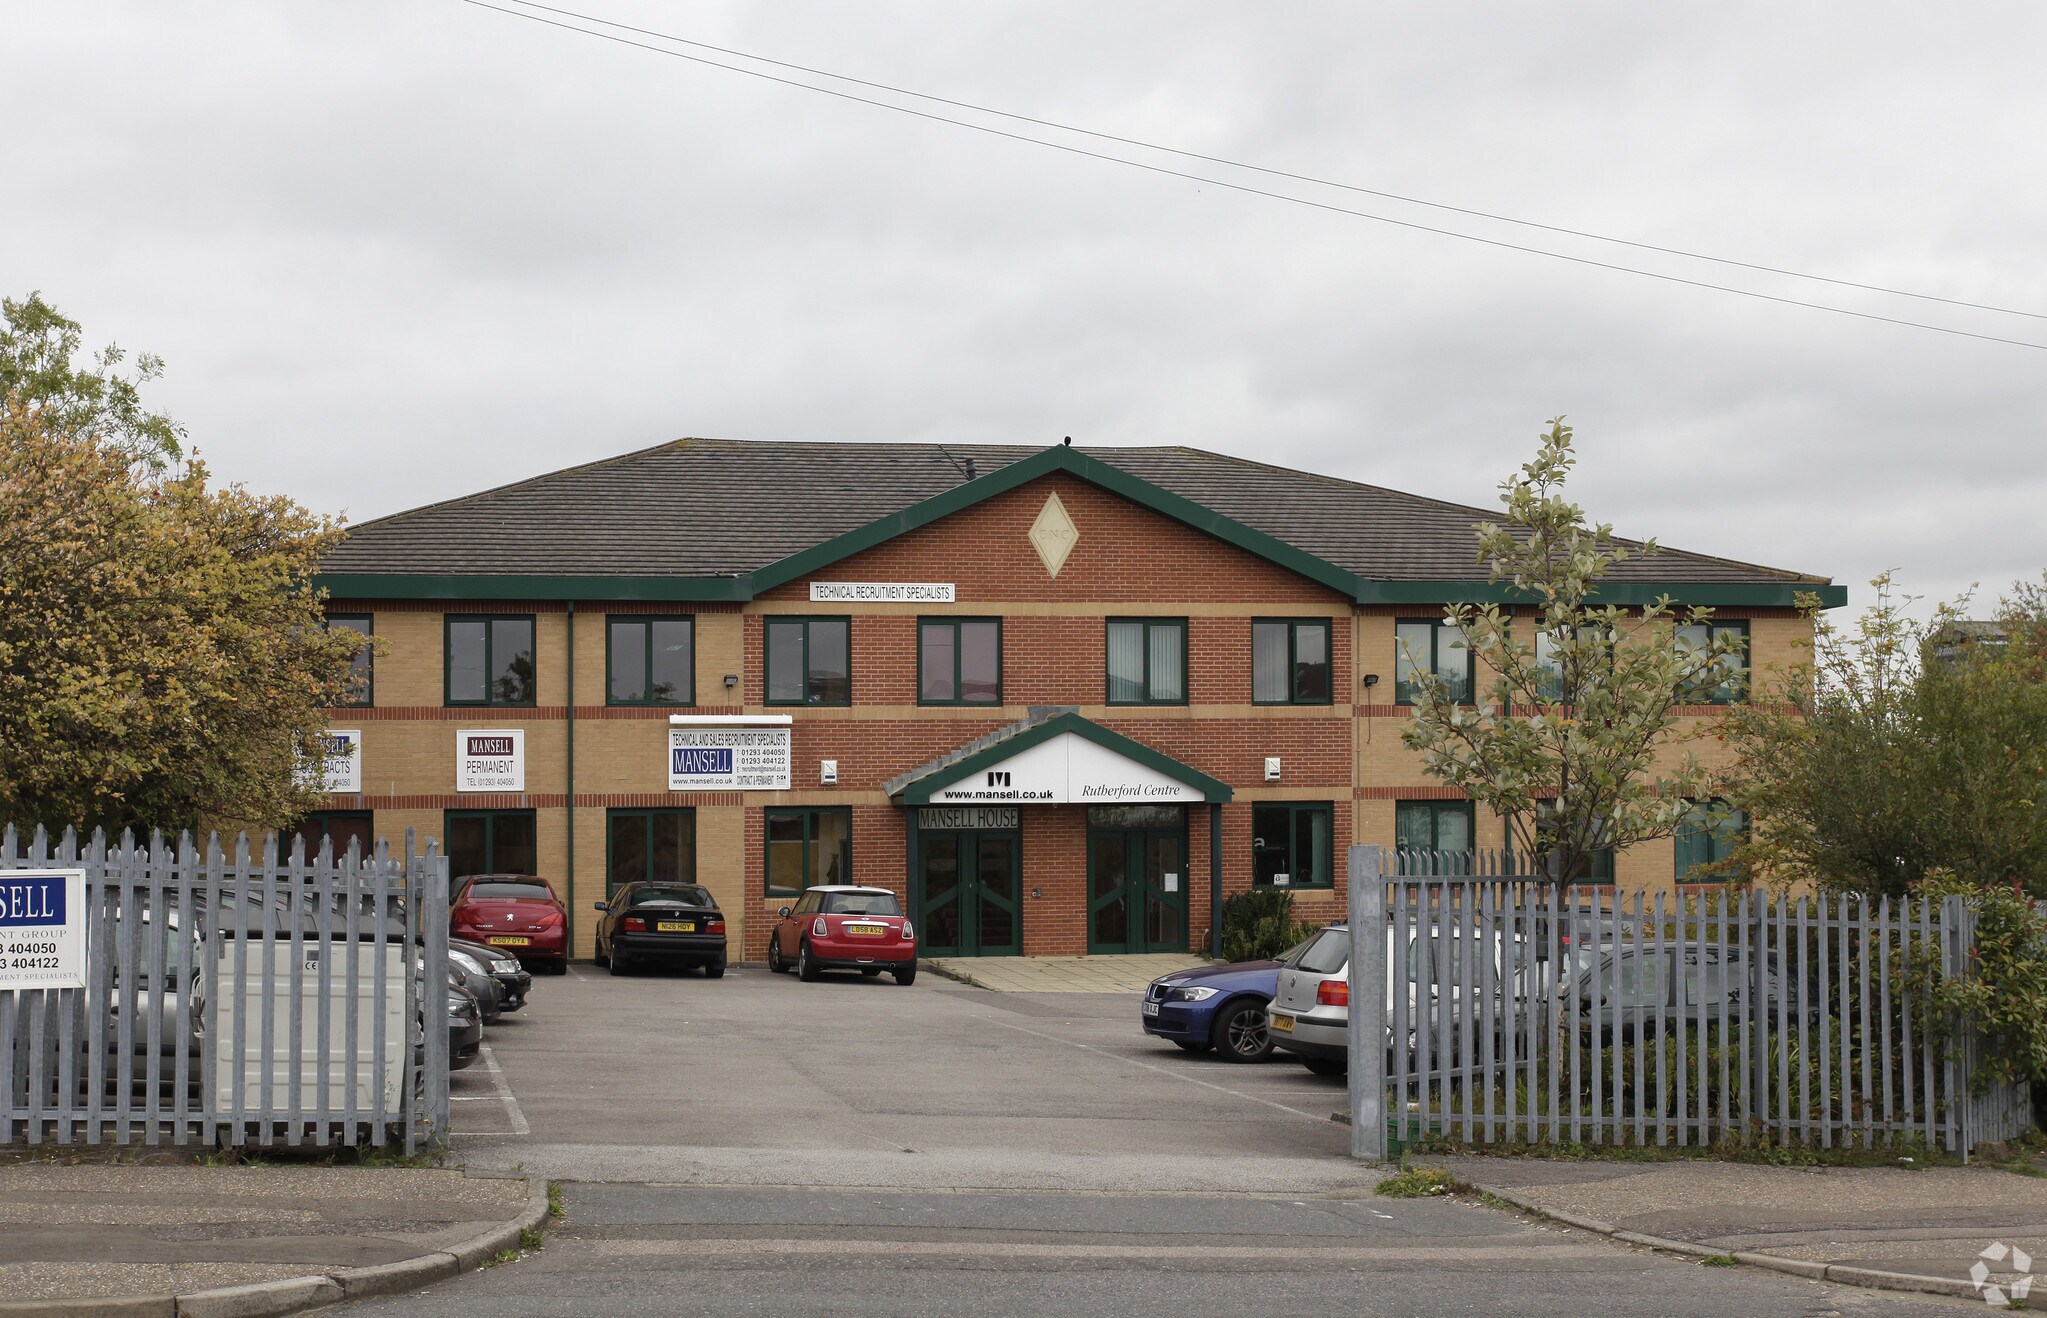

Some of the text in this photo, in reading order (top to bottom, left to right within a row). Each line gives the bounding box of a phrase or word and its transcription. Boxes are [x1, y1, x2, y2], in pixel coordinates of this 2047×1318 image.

[815, 586, 950, 600] TECHNICAL RECRUITMENT SPECIALISTS
[673, 733, 787, 746] TECHNICAL AND SALES RECRUITMENT SPECIALISTS
[471, 739, 511, 753] MANSELL
[466, 760, 514, 774] PERMANENT
[674, 750, 731, 773] MANSELL
[467, 777, 476, 786] TEL
[497, 777, 514, 786] 404050
[672, 777, 733, 785] www.mansell.co.uk
[945, 789, 1054, 799] www.mansell.co.uk
[1082, 783, 1180, 800] Rutherford Centre
[920, 808, 1018, 828] MANSELL HOUSE
[22, 930, 67, 938] GROUP
[8, 943, 56, 954] 404050
[12, 957, 59, 968] 404122
[25, 972, 78, 980] SPECIALISTS
